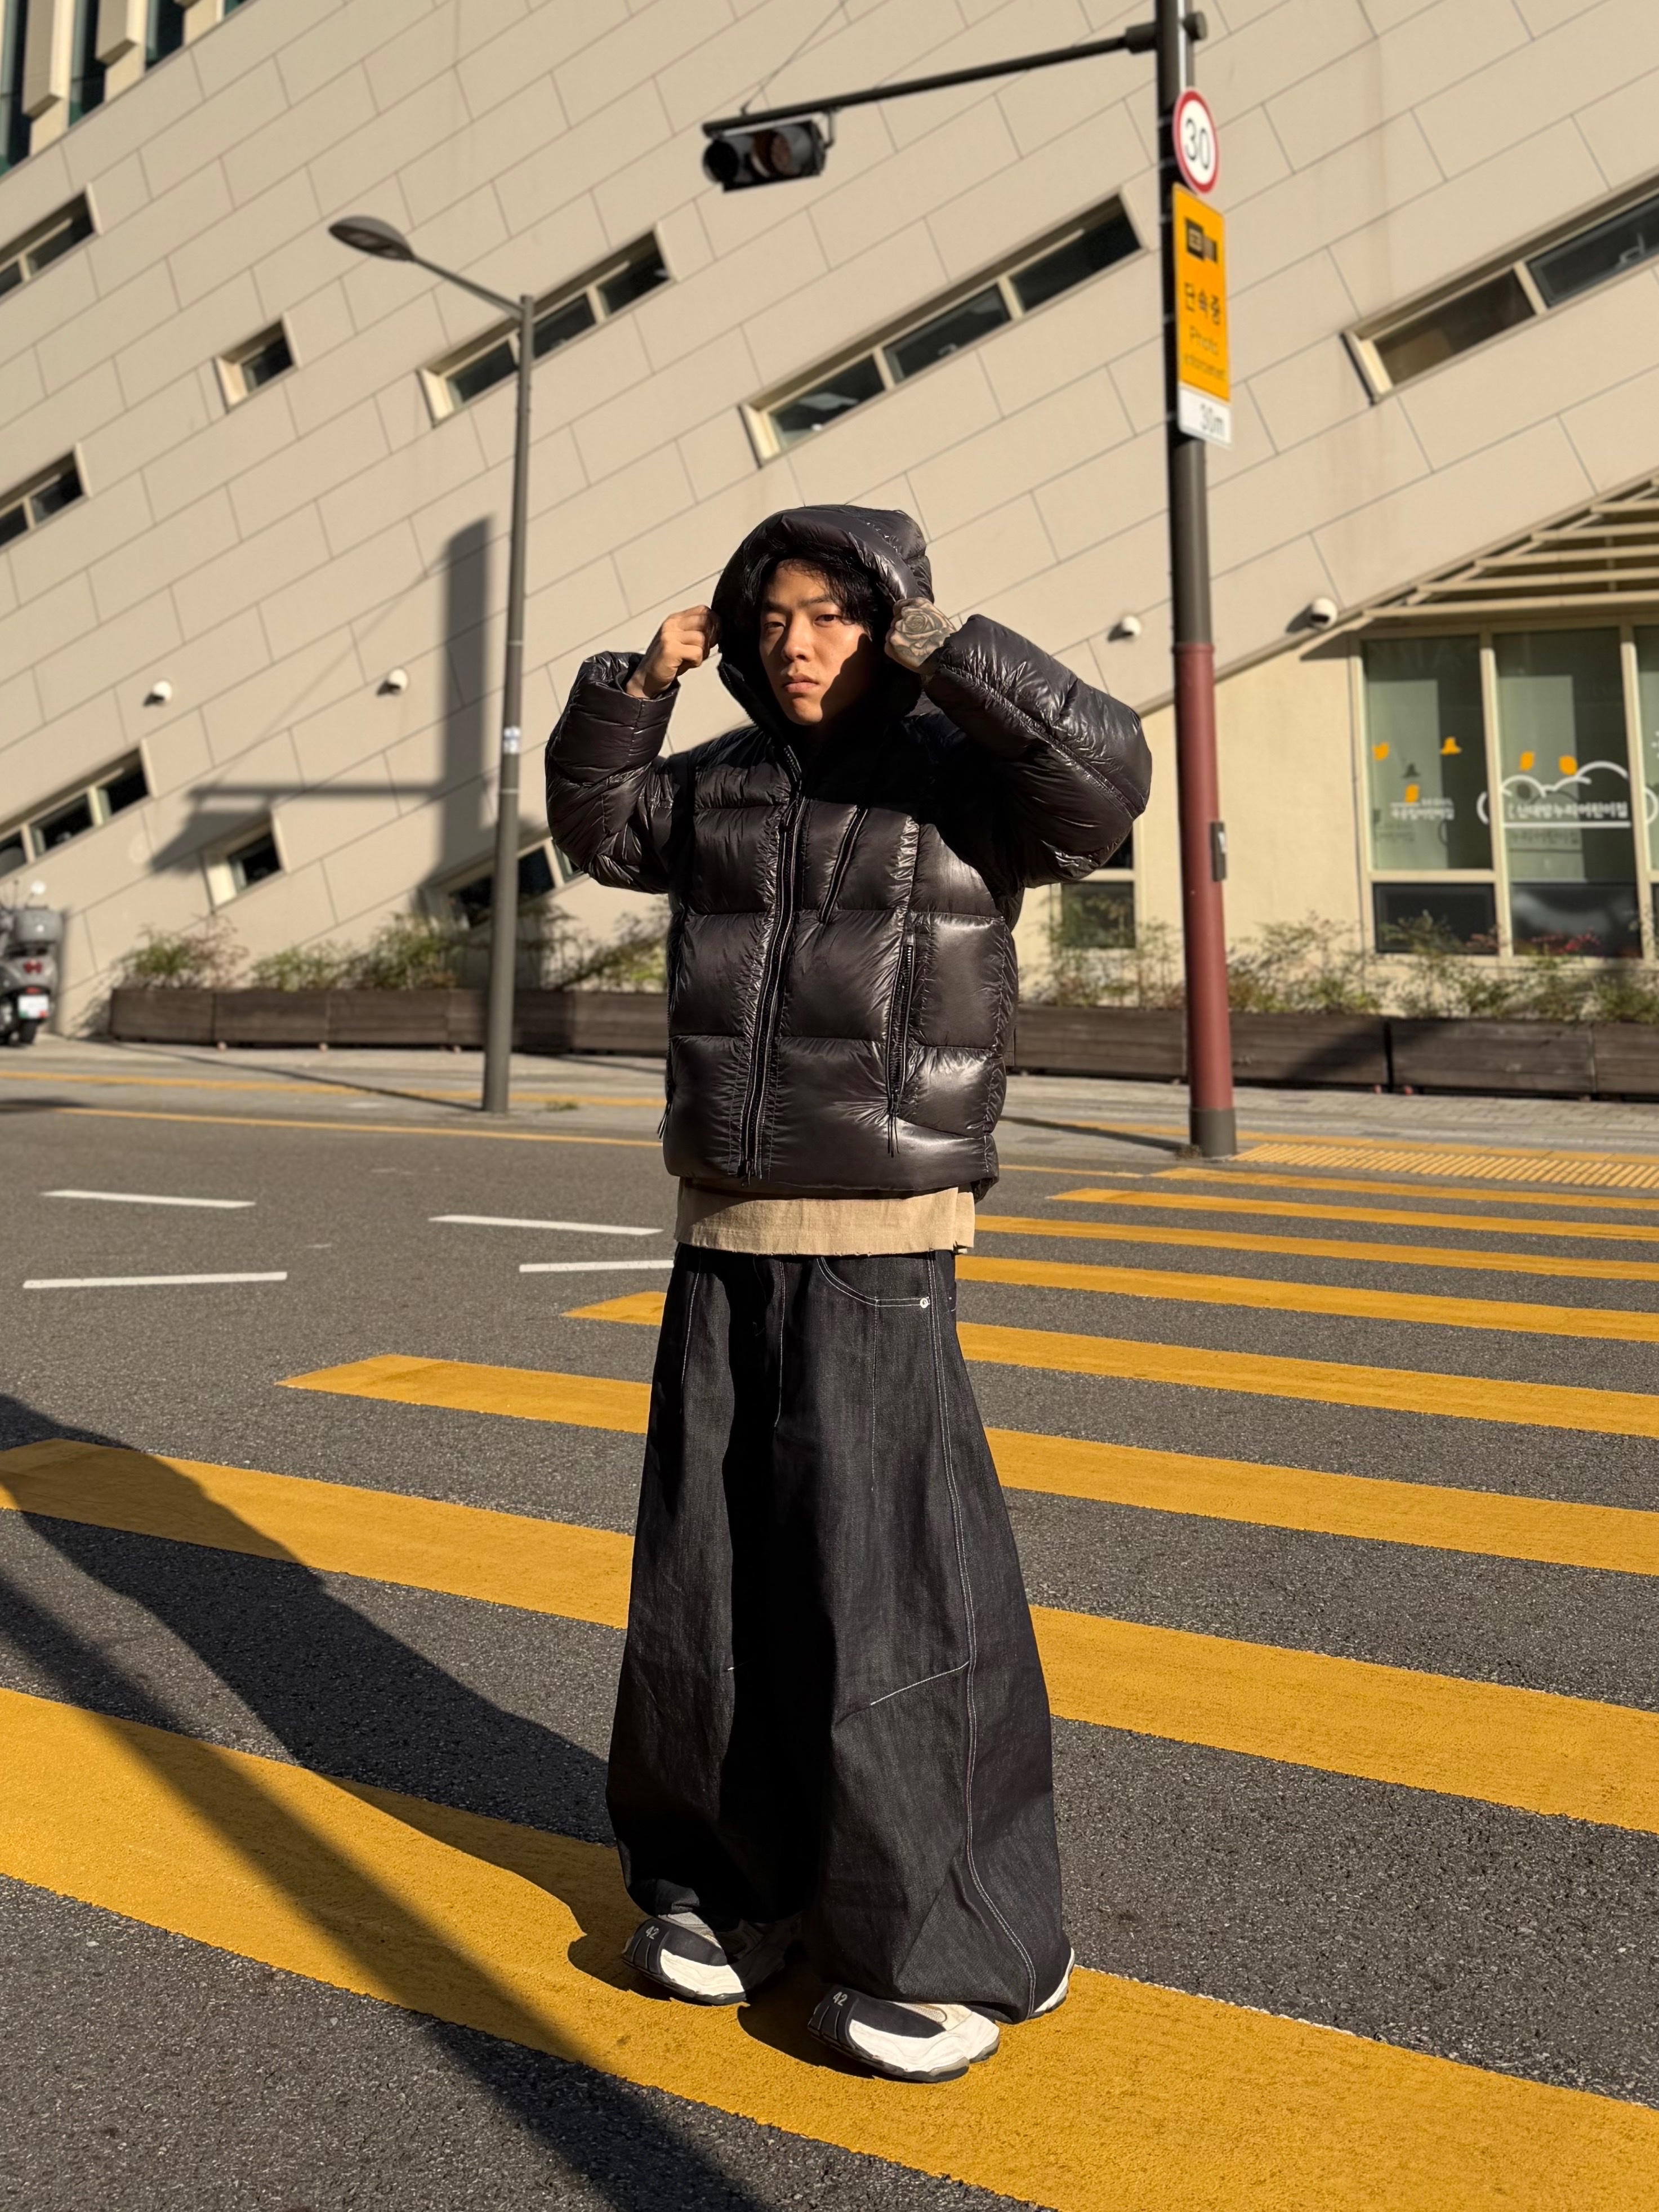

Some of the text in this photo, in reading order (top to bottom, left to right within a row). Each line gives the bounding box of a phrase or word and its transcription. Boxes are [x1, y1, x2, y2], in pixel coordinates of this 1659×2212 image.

[1185, 117, 1211, 170] 30
[1184, 282, 1221, 326] 단속중
[645, 1926, 659, 1940] 42
[833, 1991, 848, 2006] 42
